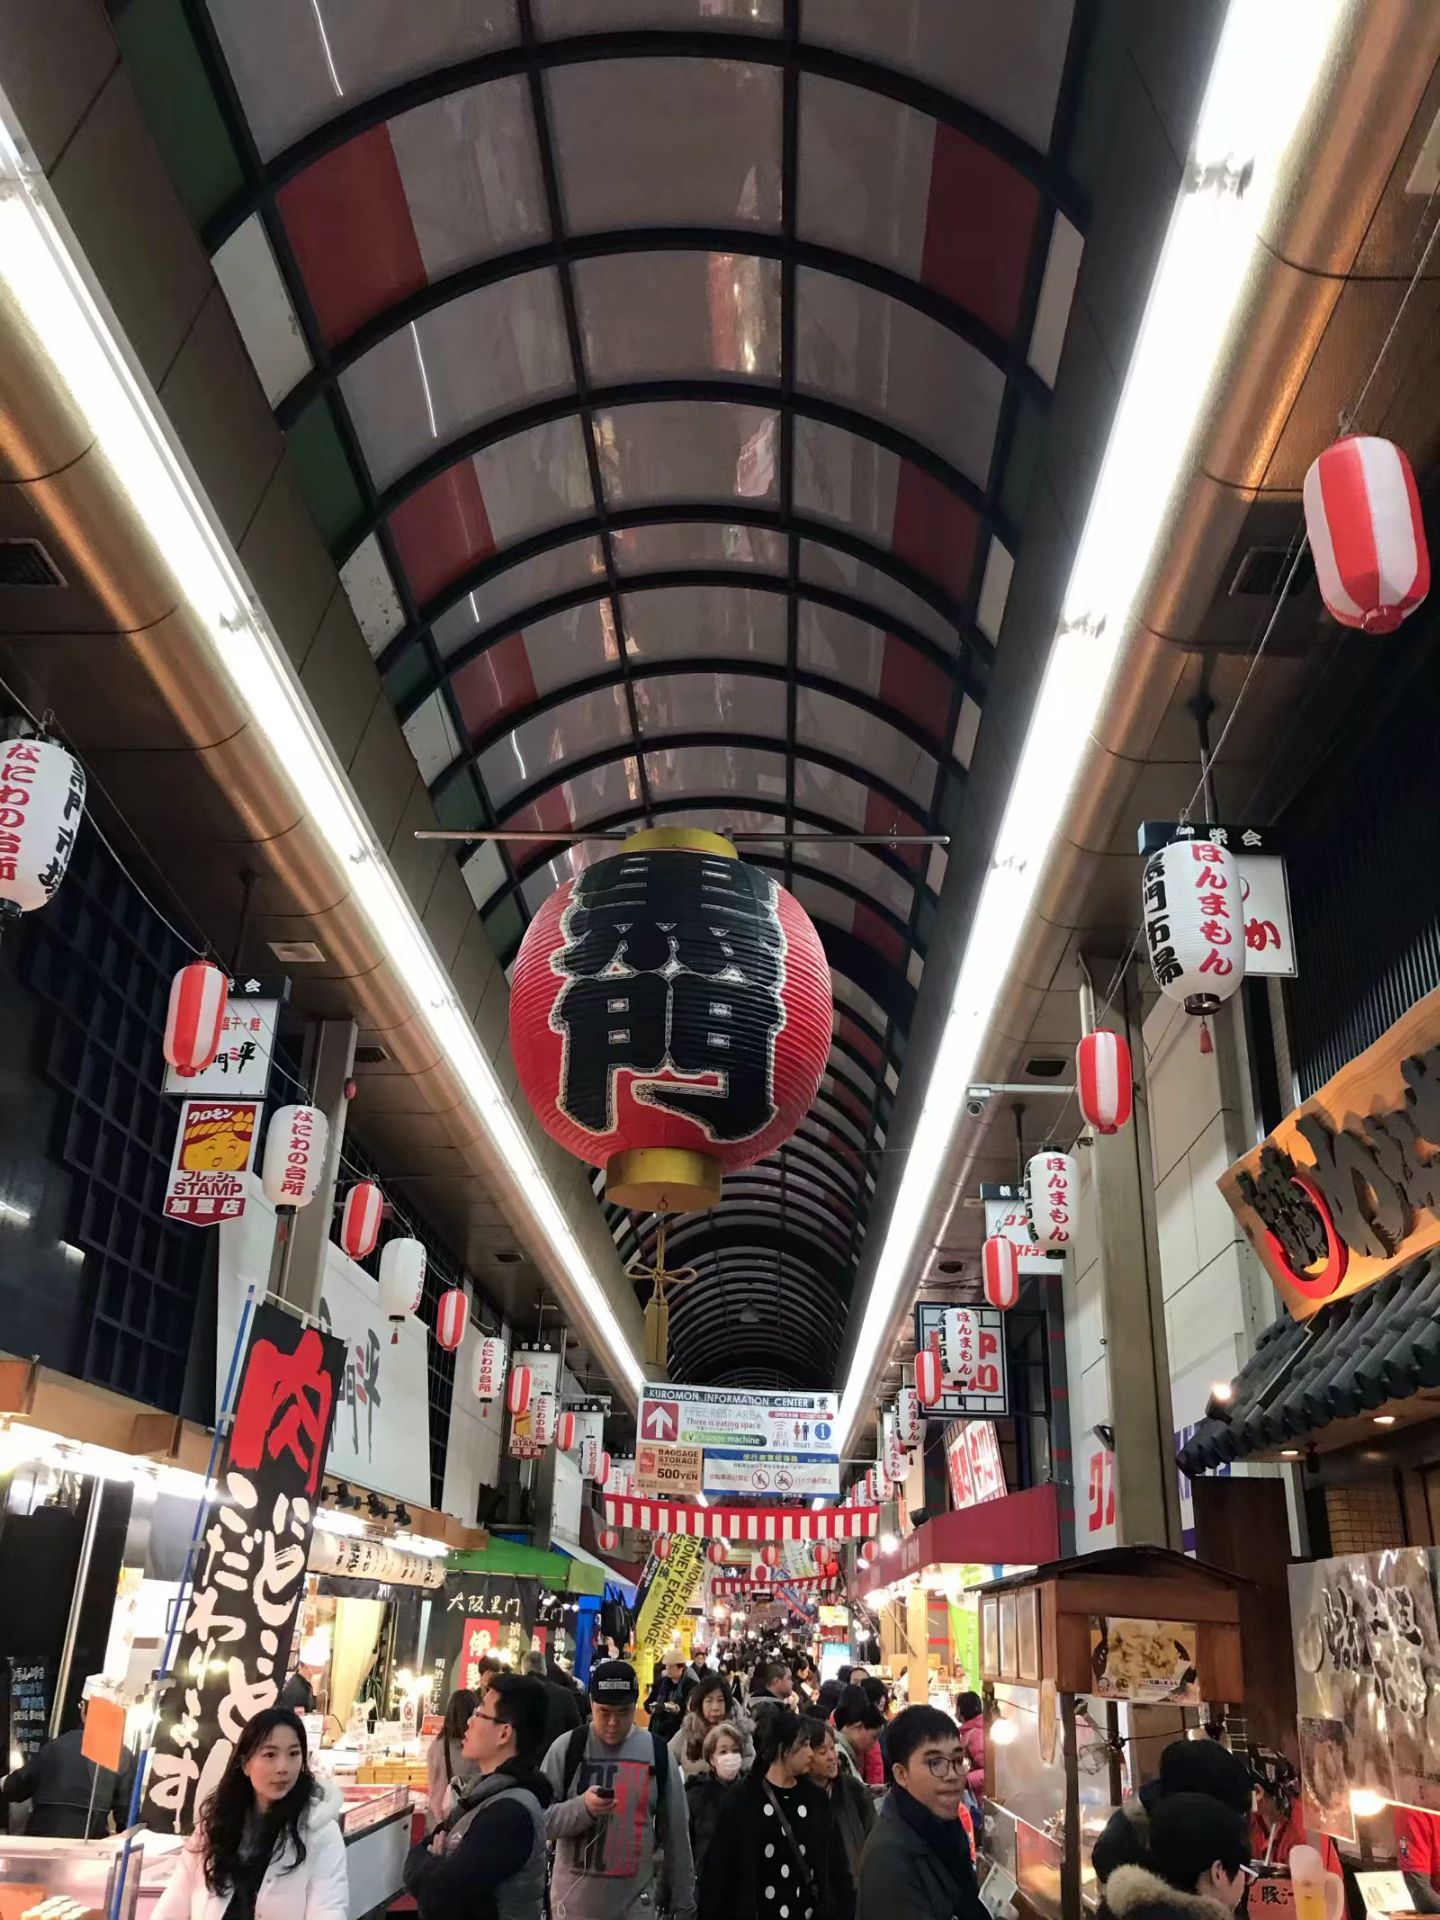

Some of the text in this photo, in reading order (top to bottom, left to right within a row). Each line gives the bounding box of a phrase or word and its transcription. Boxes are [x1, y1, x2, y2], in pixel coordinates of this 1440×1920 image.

[1191, 843, 1233, 976] ほんまもん
[199, 1041, 257, 1075] 門三平
[188, 1108, 234, 1125] クロモン
[280, 1108, 313, 1196] なにわの台所
[173, 1182, 243, 1197] STAMP
[181, 1170, 236, 1184] フレッシュ
[169, 1197, 241, 1215] 加盟店
[1047, 1156, 1070, 1243] ほんまもん
[955, 1311, 973, 1375] ほんまもん
[478, 1338, 496, 1393] なにわの台所
[228, 1327, 336, 1496] 肉
[534, 1397, 547, 1441] なにわの台所
[649, 1389, 809, 1408] KUROMON INFORMATION CENTER
[511, 1438, 538, 1448] STAM
[686, 1417, 761, 1431] There is eating space
[727, 1434, 760, 1445] machine
[658, 1448, 699, 1458] BAGGAGE
[658, 1456, 699, 1465] STORAGE
[674, 1536, 699, 1578] MONEY
[446, 1591, 520, 1617] 大阪黒門
[681, 1562, 703, 1604] MONEY
[644, 1578, 681, 1646] EXCHANGE
[653, 1601, 685, 1663] EXCHANGE
[149, 1470, 263, 1835] こだわります
[430, 1658, 446, 1714] 明治三十年
